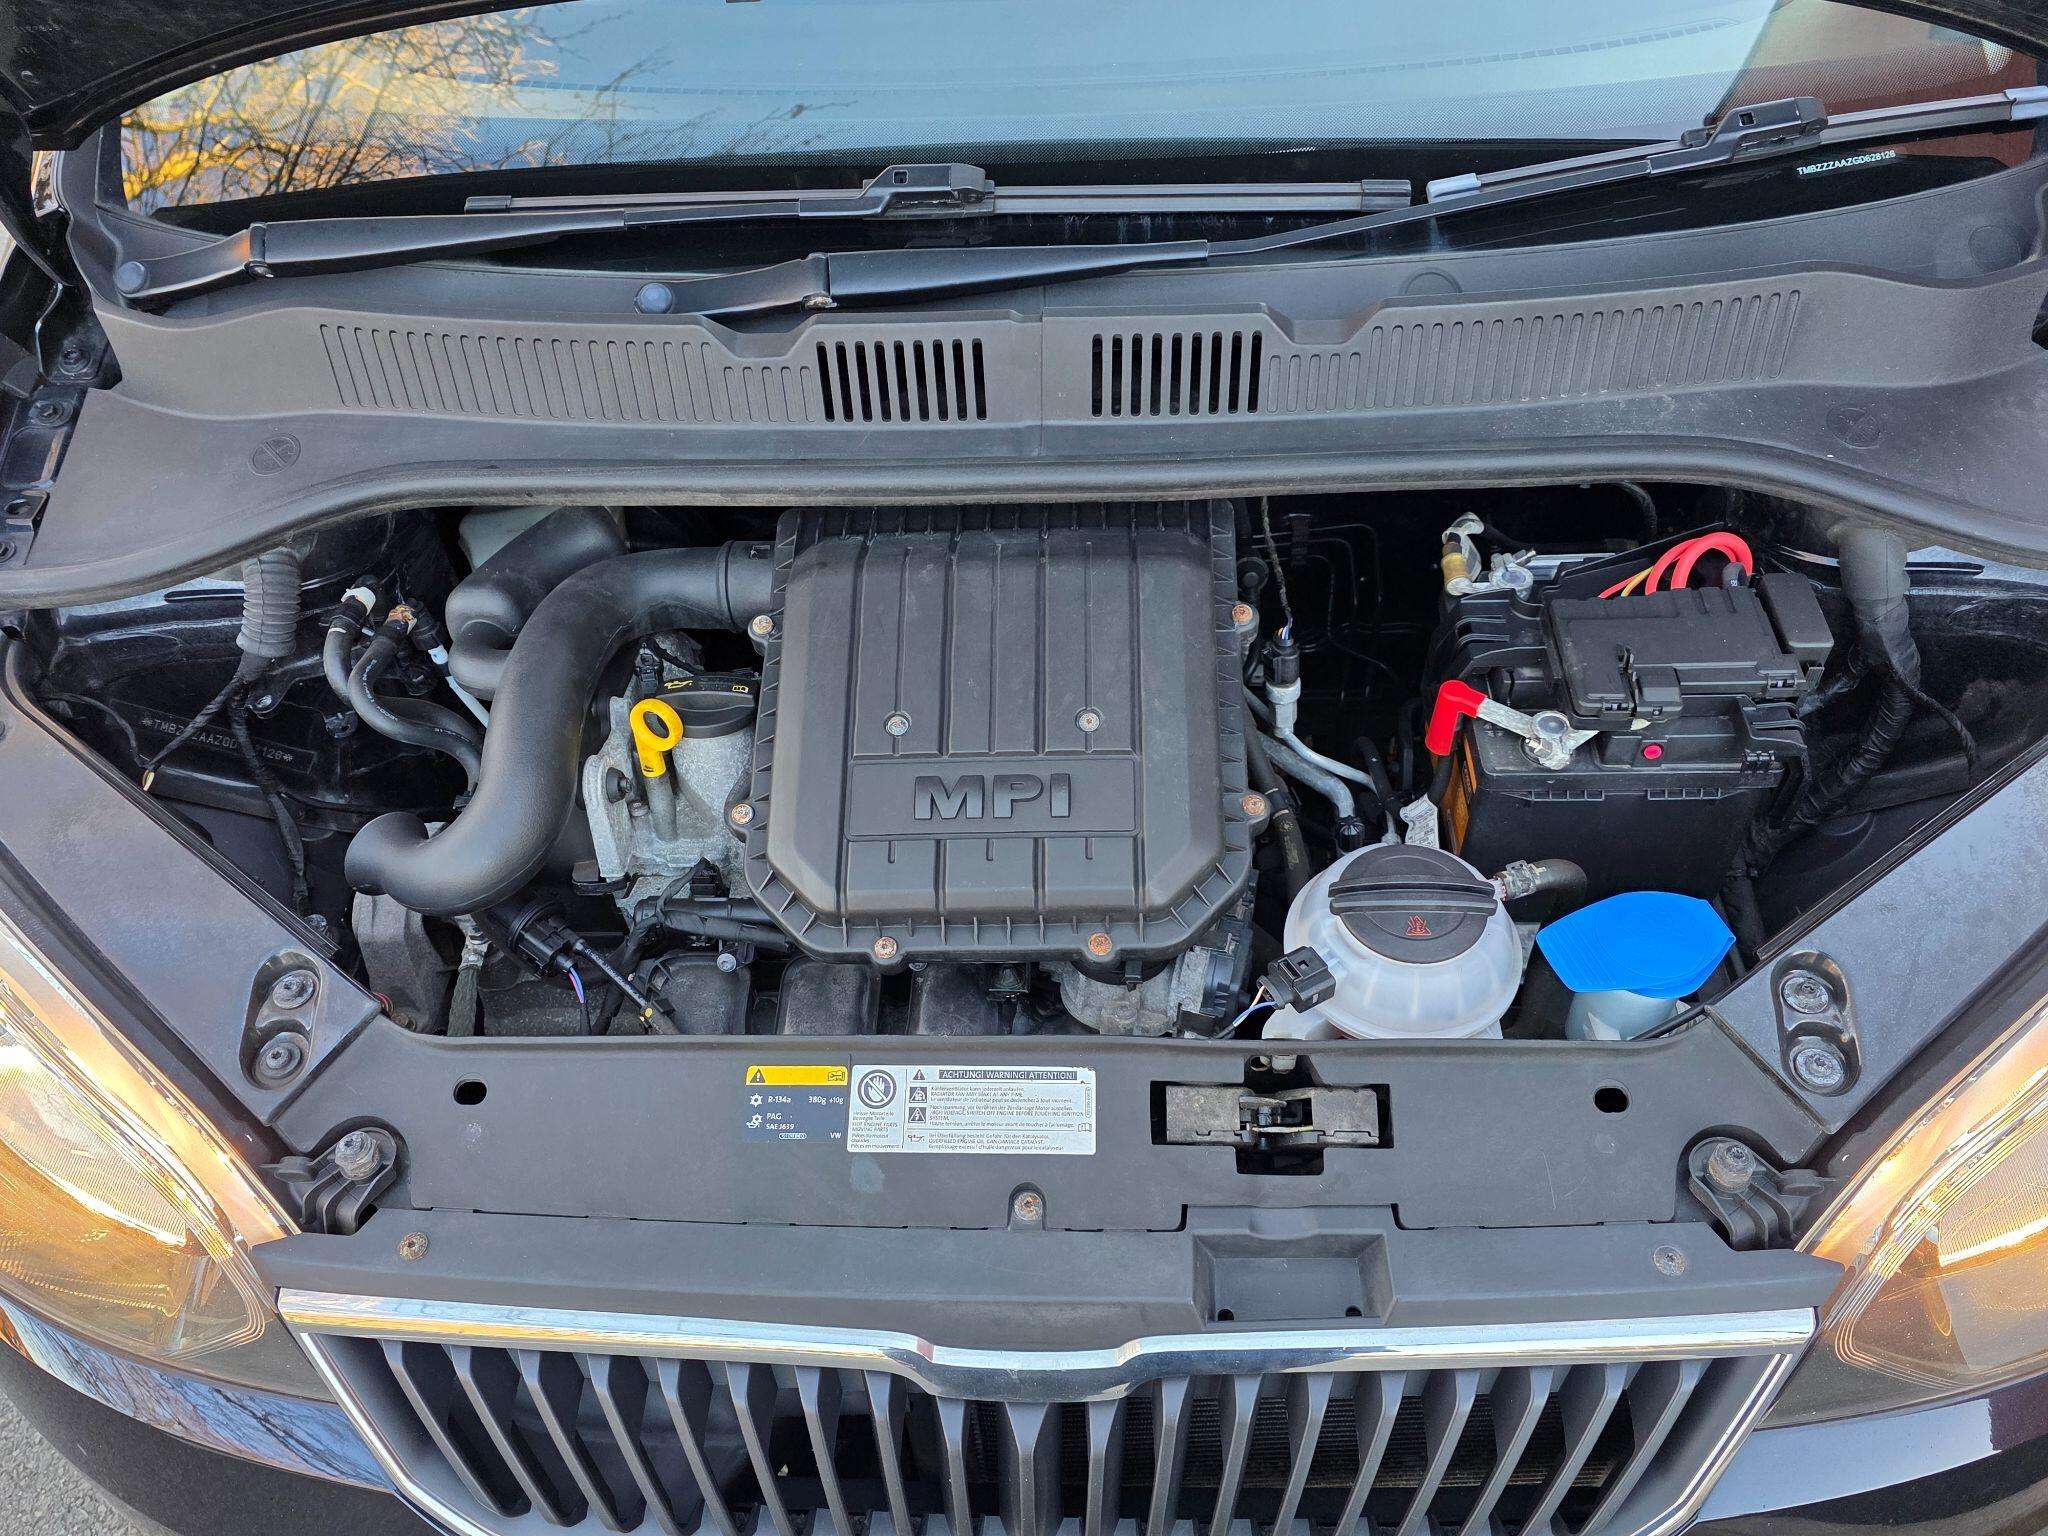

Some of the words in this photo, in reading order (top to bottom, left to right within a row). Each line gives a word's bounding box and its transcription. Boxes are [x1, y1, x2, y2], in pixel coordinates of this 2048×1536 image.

[914, 773, 1072, 820] MPI
[942, 1071, 983, 1079] ACHTUNG!
[986, 1071, 1027, 1079] WARNING!
[1029, 1071, 1075, 1080] ATTENTION!
[766, 1112, 782, 1120] PAG
